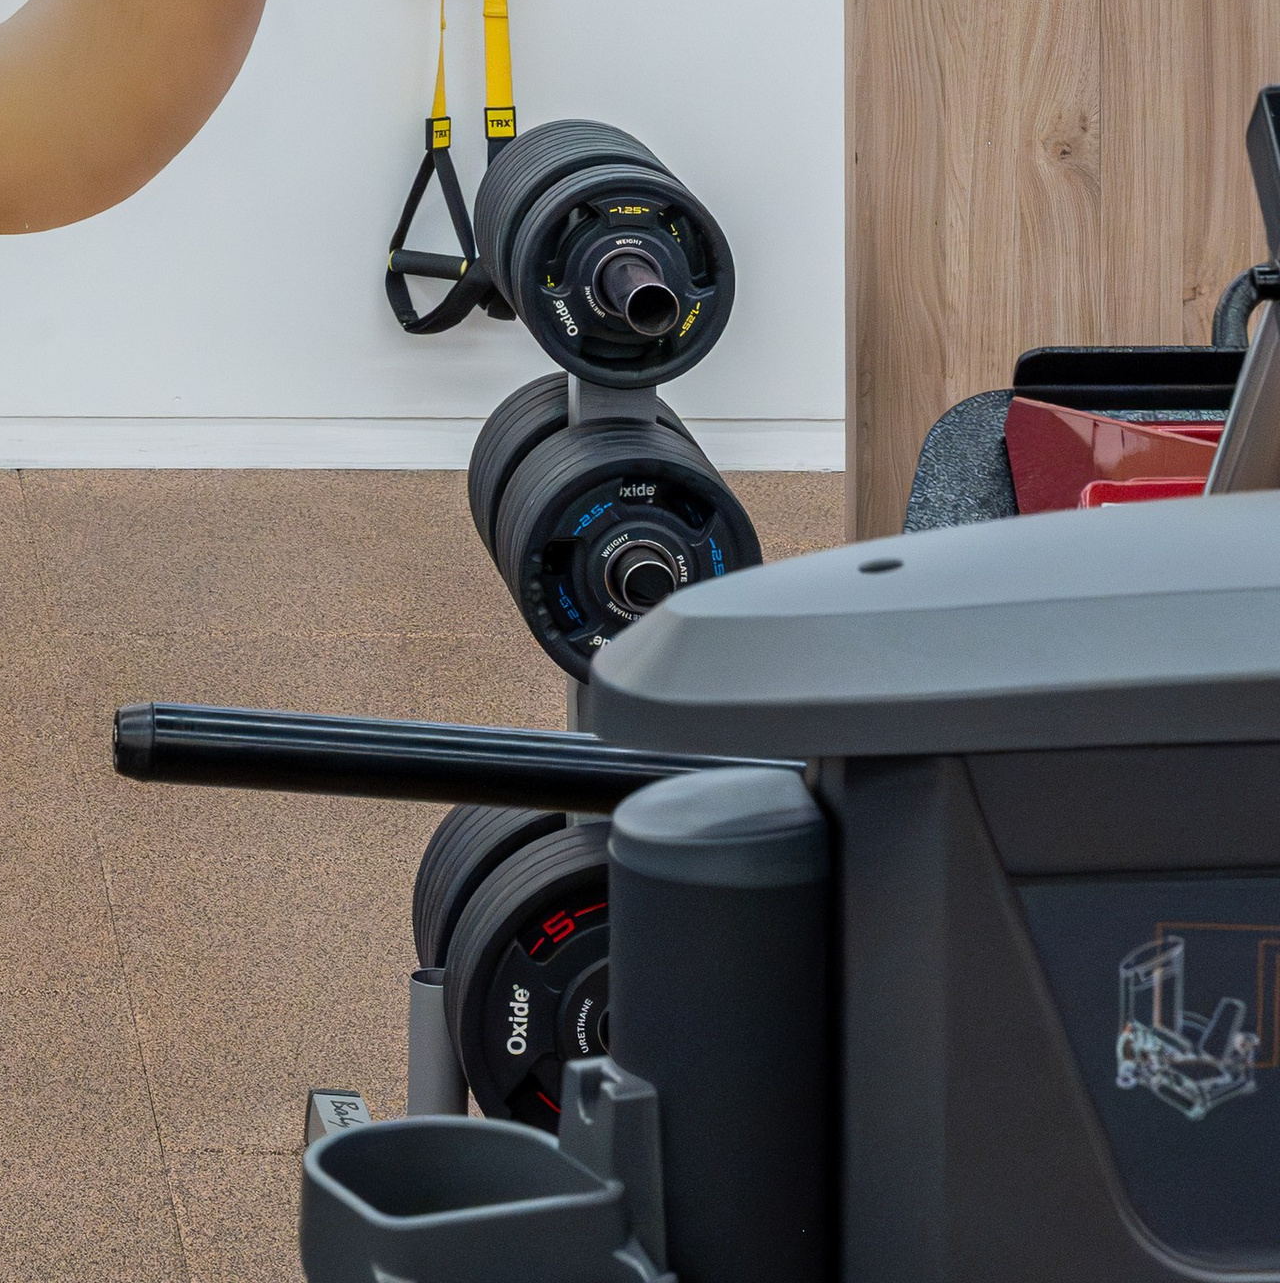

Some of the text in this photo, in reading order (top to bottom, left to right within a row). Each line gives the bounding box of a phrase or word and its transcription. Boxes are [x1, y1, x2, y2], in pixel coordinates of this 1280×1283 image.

[434, 129, 447, 139] TRX
[489, 119, 511, 128] TRX
[555, 299, 579, 337] Oxide
[619, 483, 655, 497] xide
[601, 533, 629, 558] WEIGHT
[676, 554, 688, 583] PLATE
[506, 987, 530, 1056] Oxide
[576, 997, 594, 1054] URETHANE
